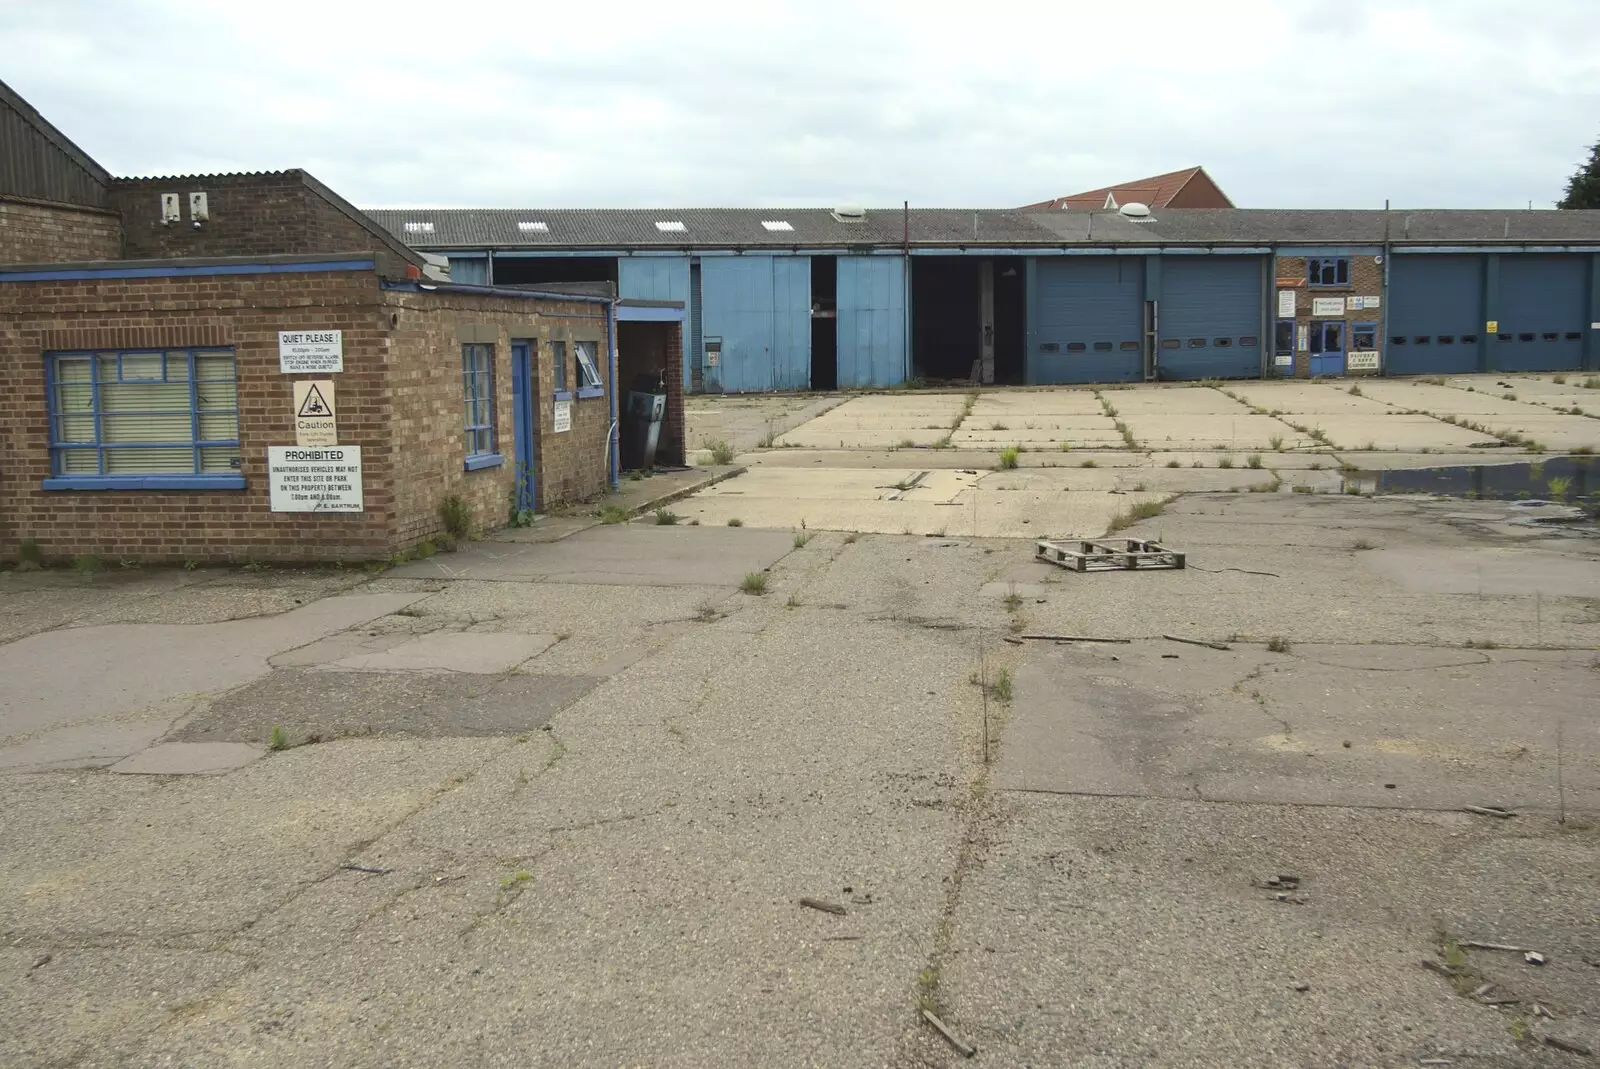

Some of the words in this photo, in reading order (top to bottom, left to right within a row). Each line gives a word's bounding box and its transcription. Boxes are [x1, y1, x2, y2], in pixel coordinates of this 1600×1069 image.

[282, 334, 303, 344] QUIET
[306, 333, 333, 343] PLEASE
[298, 421, 334, 429] Caution
[285, 450, 344, 460] PROHIBITED
